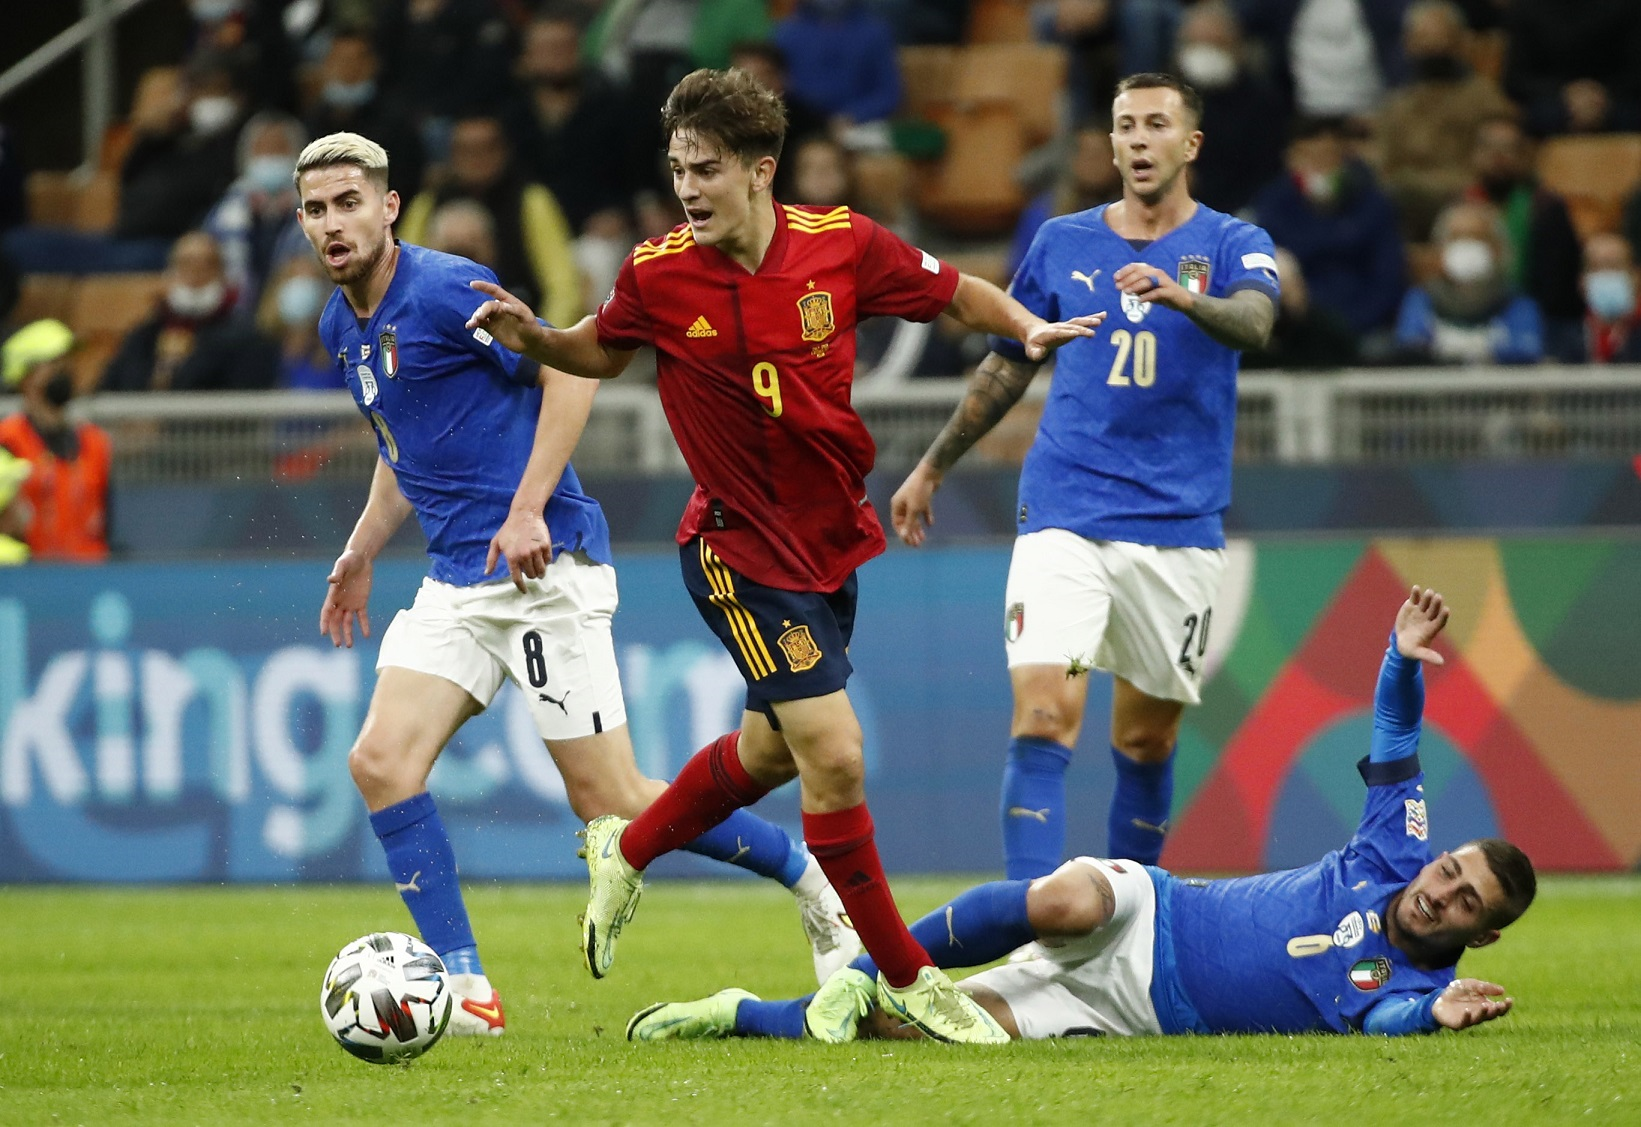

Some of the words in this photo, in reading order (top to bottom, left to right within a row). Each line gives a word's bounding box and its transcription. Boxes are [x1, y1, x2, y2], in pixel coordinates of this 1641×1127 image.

[686, 329, 718, 338] adidas
[1107, 329, 1156, 387] 20
[752, 361, 783, 418] 9
[522, 630, 548, 688] 8
[1180, 606, 1212, 663] 20
